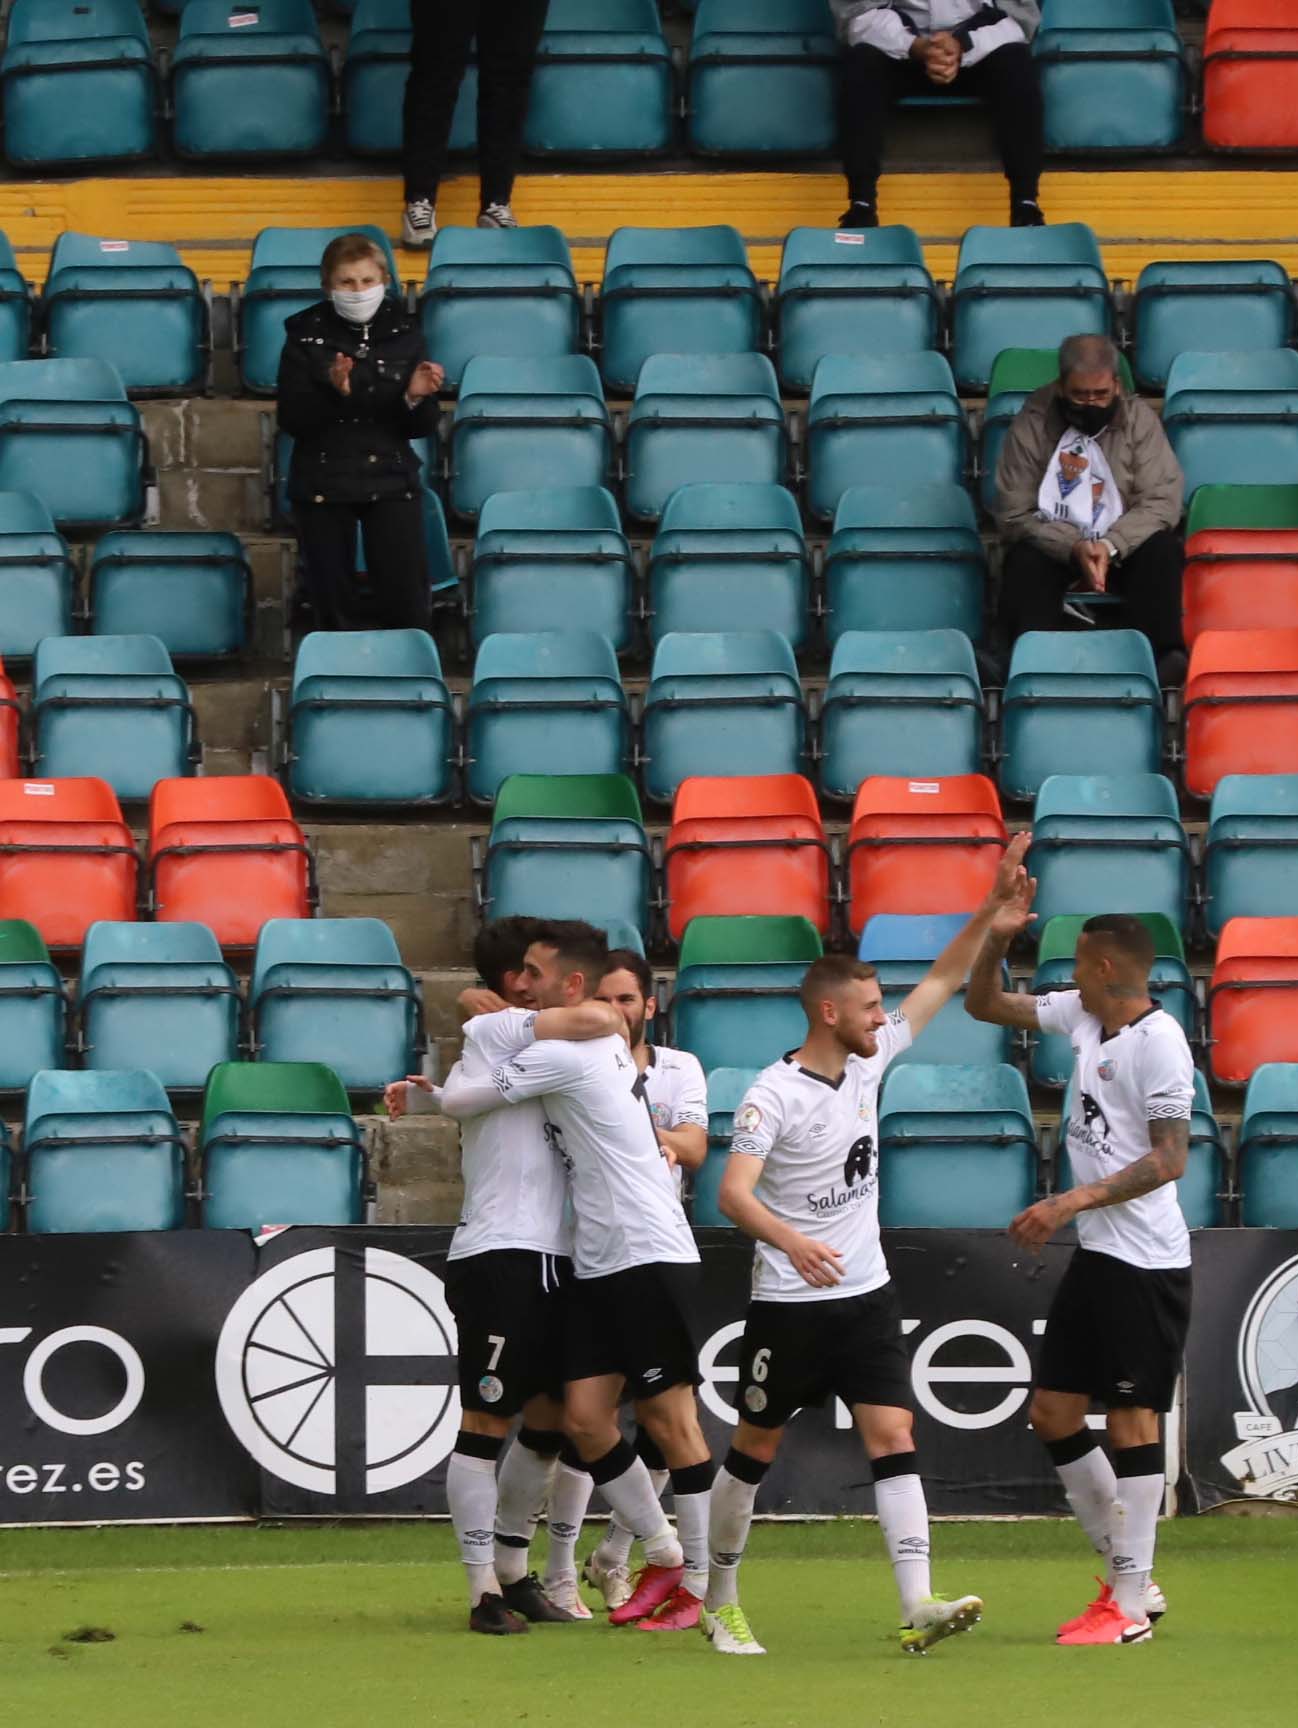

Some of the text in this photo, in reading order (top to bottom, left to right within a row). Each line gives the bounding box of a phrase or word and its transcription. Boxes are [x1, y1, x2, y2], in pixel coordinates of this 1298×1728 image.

[807, 1178, 877, 1212] Salama
[486, 1335, 506, 1372] 7
[752, 1347, 772, 1383] 6
[0, 1460, 146, 1494] ez.es
